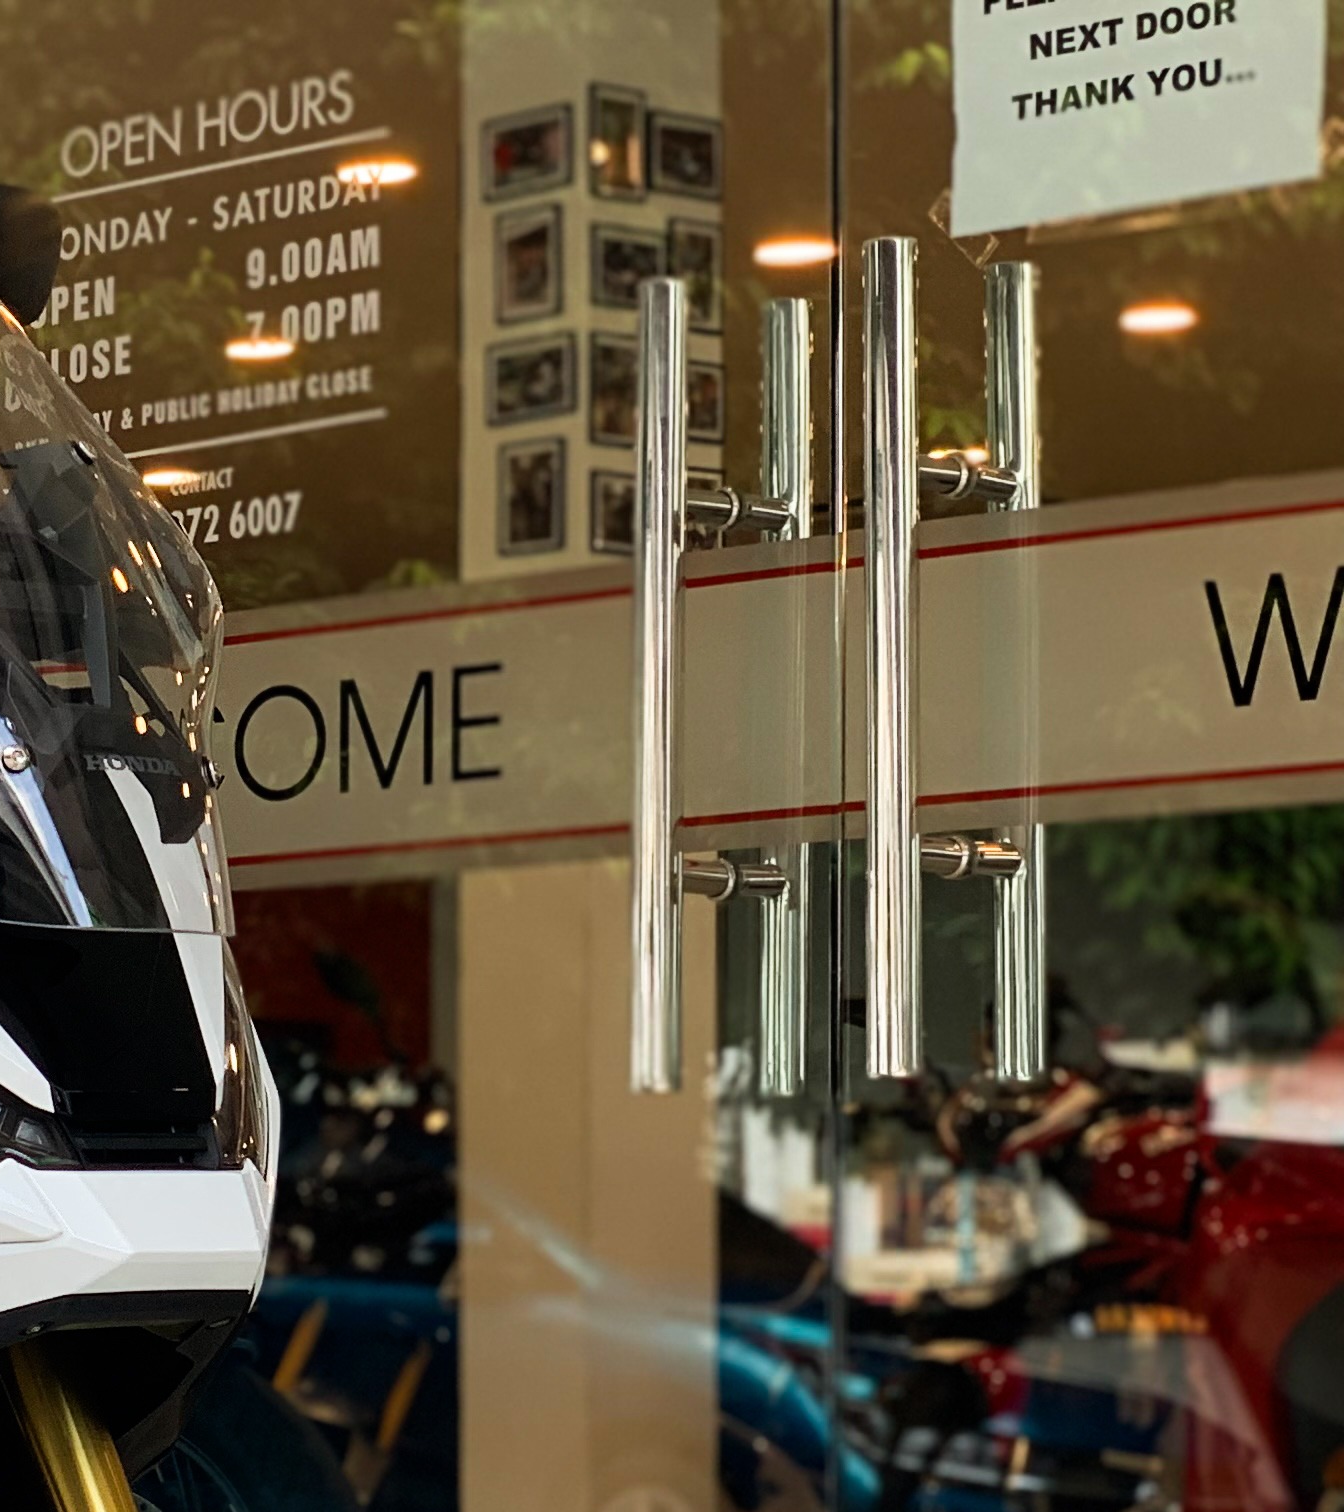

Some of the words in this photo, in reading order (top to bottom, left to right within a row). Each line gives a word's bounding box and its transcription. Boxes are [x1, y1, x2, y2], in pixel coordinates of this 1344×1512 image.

[1029, 18, 1123, 60] NEXT
[1135, 0, 1237, 41] DOOR
[61, 106, 182, 178] OPEN
[197, 69, 354, 151] HOURS
[1011, 73, 1135, 120] THANK
[59, 206, 172, 261] ONDAY
[213, 164, 383, 231] SATURDAY
[246, 226, 380, 289] 9.00AM
[39, 335, 132, 384] LOSE
[141, 394, 210, 427] PUBLIC
[217, 379, 300, 415] HOLIDAY
[306, 365, 373, 400] CLOSE
[229, 491, 302, 539] 6007
[214, 661, 503, 802] OME
[83, 753, 183, 777] HONDA
